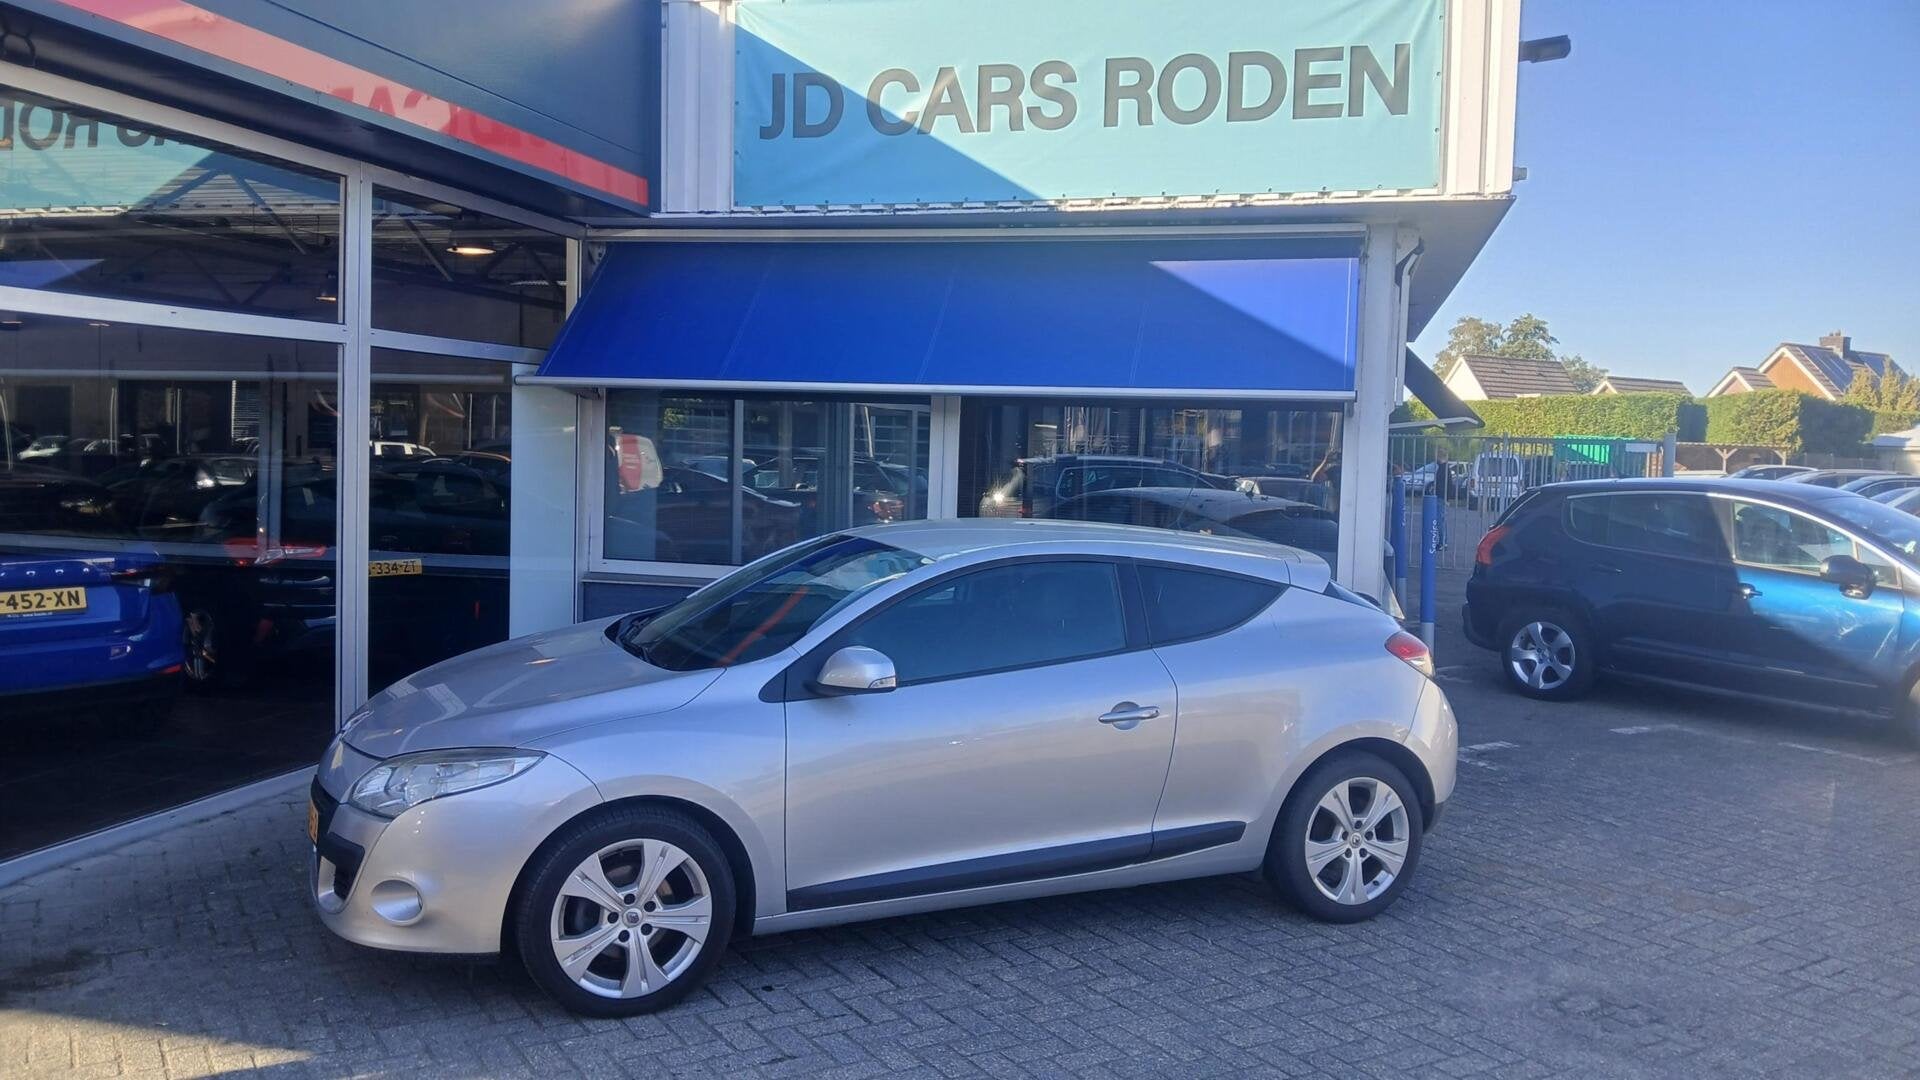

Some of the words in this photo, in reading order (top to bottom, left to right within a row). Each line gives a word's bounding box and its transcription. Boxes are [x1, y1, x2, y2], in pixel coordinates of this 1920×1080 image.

[759, 72, 844, 140] JD
[866, 60, 1078, 136] CARS
[1103, 43, 1411, 128] RODEN
